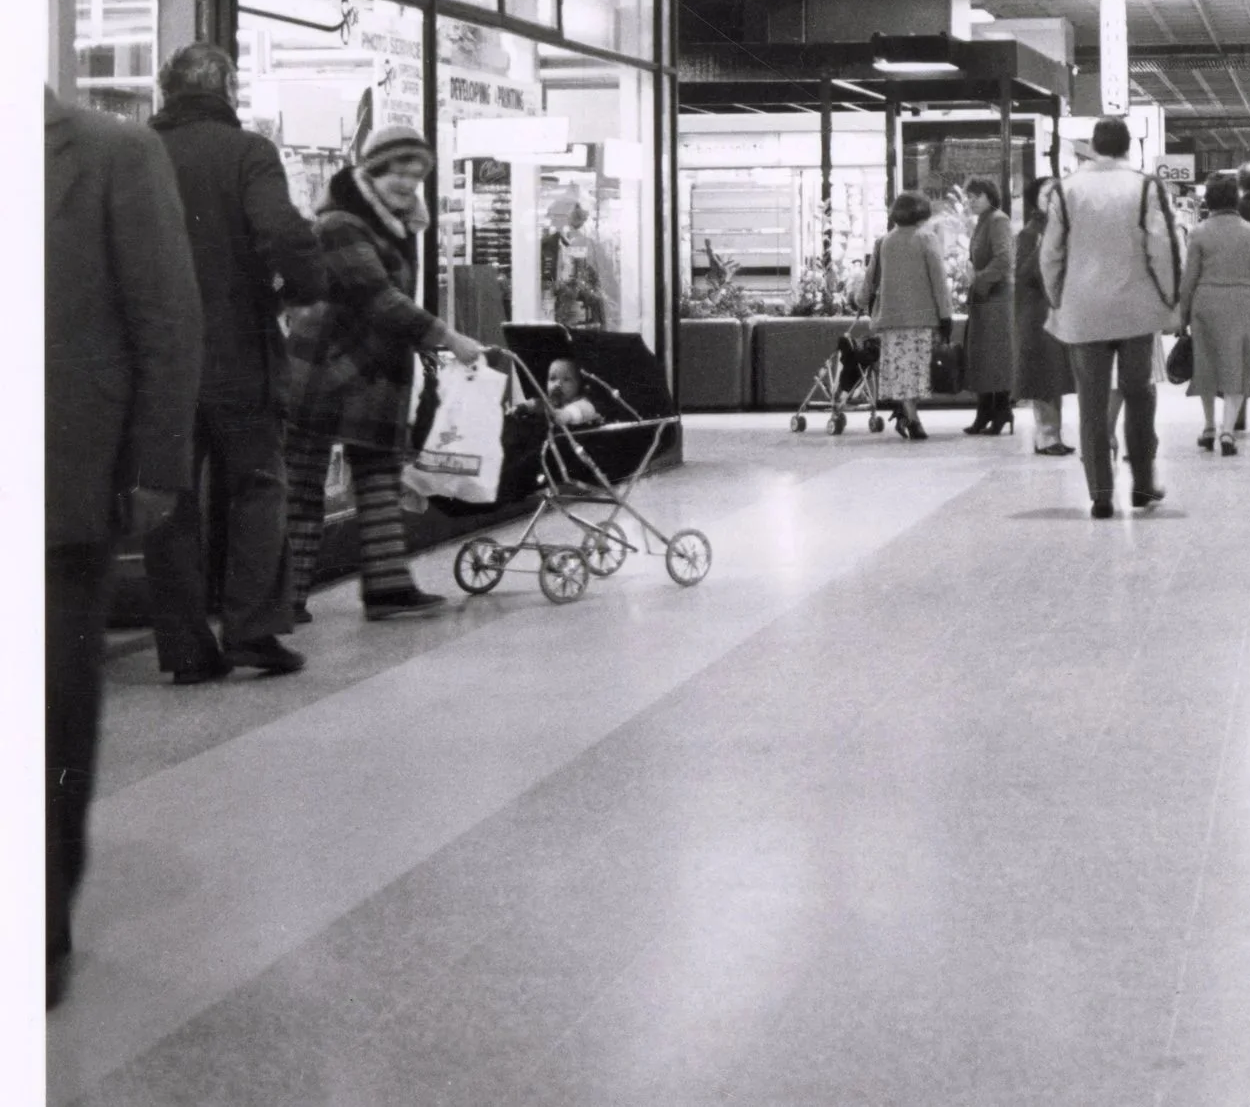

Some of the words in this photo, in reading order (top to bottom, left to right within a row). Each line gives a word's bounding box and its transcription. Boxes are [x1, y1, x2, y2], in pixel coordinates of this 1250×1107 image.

[450, 76, 490, 105] DEVELOPING
[498, 84, 524, 111] PRINTING
[1157, 164, 1190, 180] Gas
